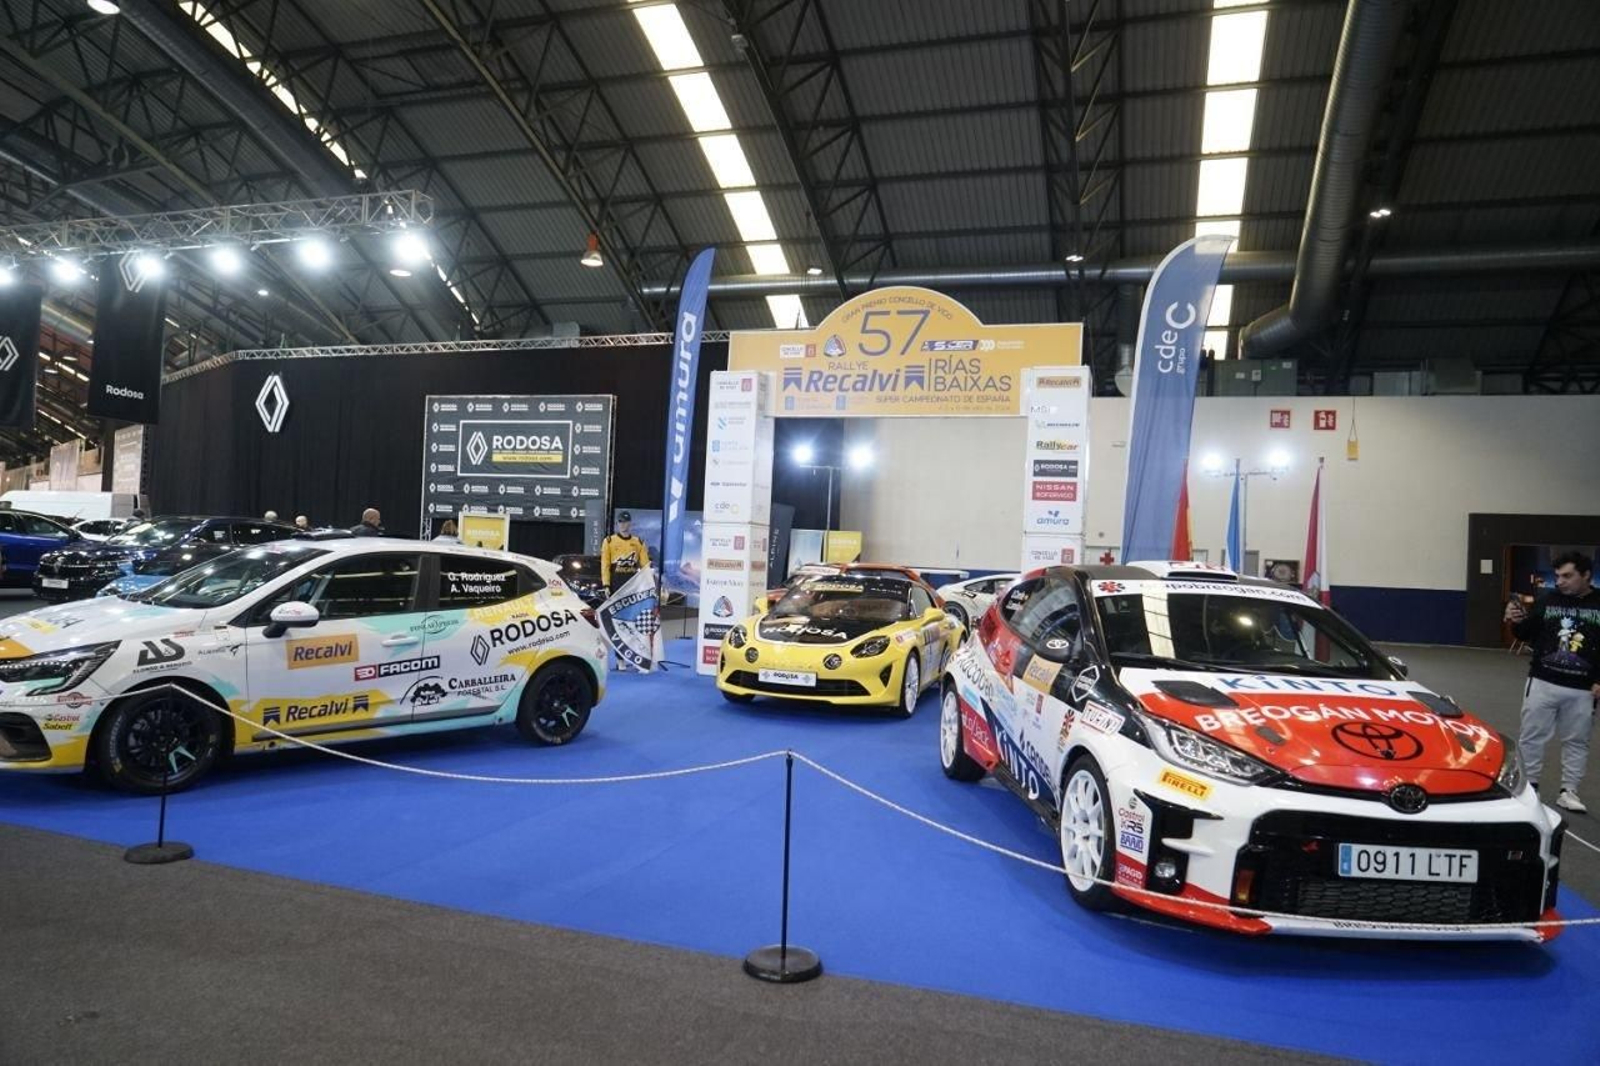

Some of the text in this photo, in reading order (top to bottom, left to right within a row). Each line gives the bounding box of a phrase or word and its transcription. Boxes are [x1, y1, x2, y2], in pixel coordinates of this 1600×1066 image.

[858, 309, 931, 357] 57
[828, 361, 869, 371] RALLYE
[934, 355, 981, 375] RÍAS
[672, 311, 697, 464] amura
[805, 369, 900, 392] Recalvi
[934, 375, 1012, 392] BAIXAS
[106, 384, 144, 400] Rodosa
[493, 435, 563, 450] RODOSA
[461, 583, 502, 594] Vaqueiro
[490, 609, 578, 647] RODOSA
[293, 641, 353, 662] Recalvi
[507, 630, 571, 655] www.rodosa.com
[611, 633, 643, 664] VIGO
[380, 657, 439, 676] FACOM
[448, 673, 516, 690] CARBALLEIRA
[285, 699, 349, 722] Recalvi
[1194, 703, 1500, 743] BREOGÁN MOTOR
[1161, 771, 1207, 797] PIRELLI
[1118, 807, 1146, 823] Castrol
[1120, 833, 1144, 851] BRAID
[1357, 849, 1473, 878] 0911 LTF
